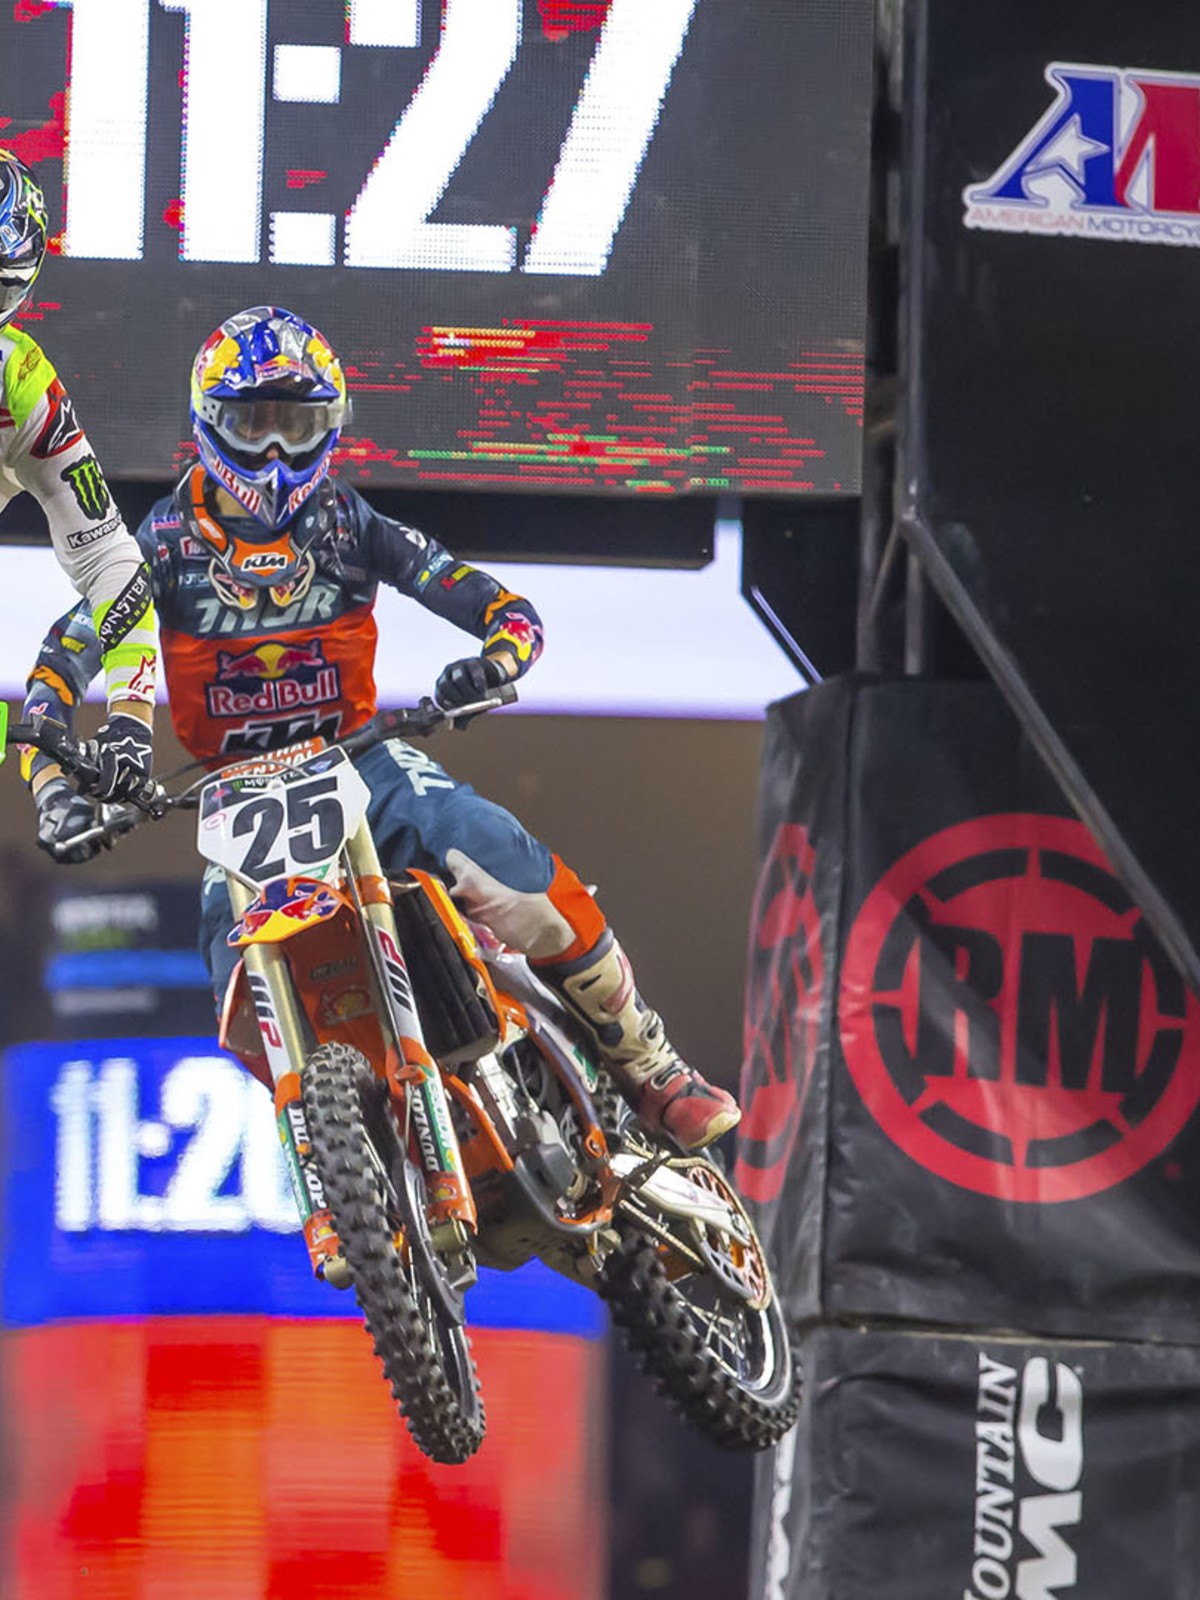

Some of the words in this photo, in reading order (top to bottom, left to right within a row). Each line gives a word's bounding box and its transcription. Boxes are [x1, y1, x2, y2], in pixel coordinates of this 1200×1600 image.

[969, 206, 1085, 230] AMERICAN
[242, 553, 288, 571] KTM
[210, 681, 275, 715] Red
[276, 668, 338, 709] Bull
[232, 775, 344, 882] 25
[914, 923, 1146, 1100] RM
[287, 1106, 328, 1209] DUOP
[963, 1352, 1018, 1600] OUNTAIN
